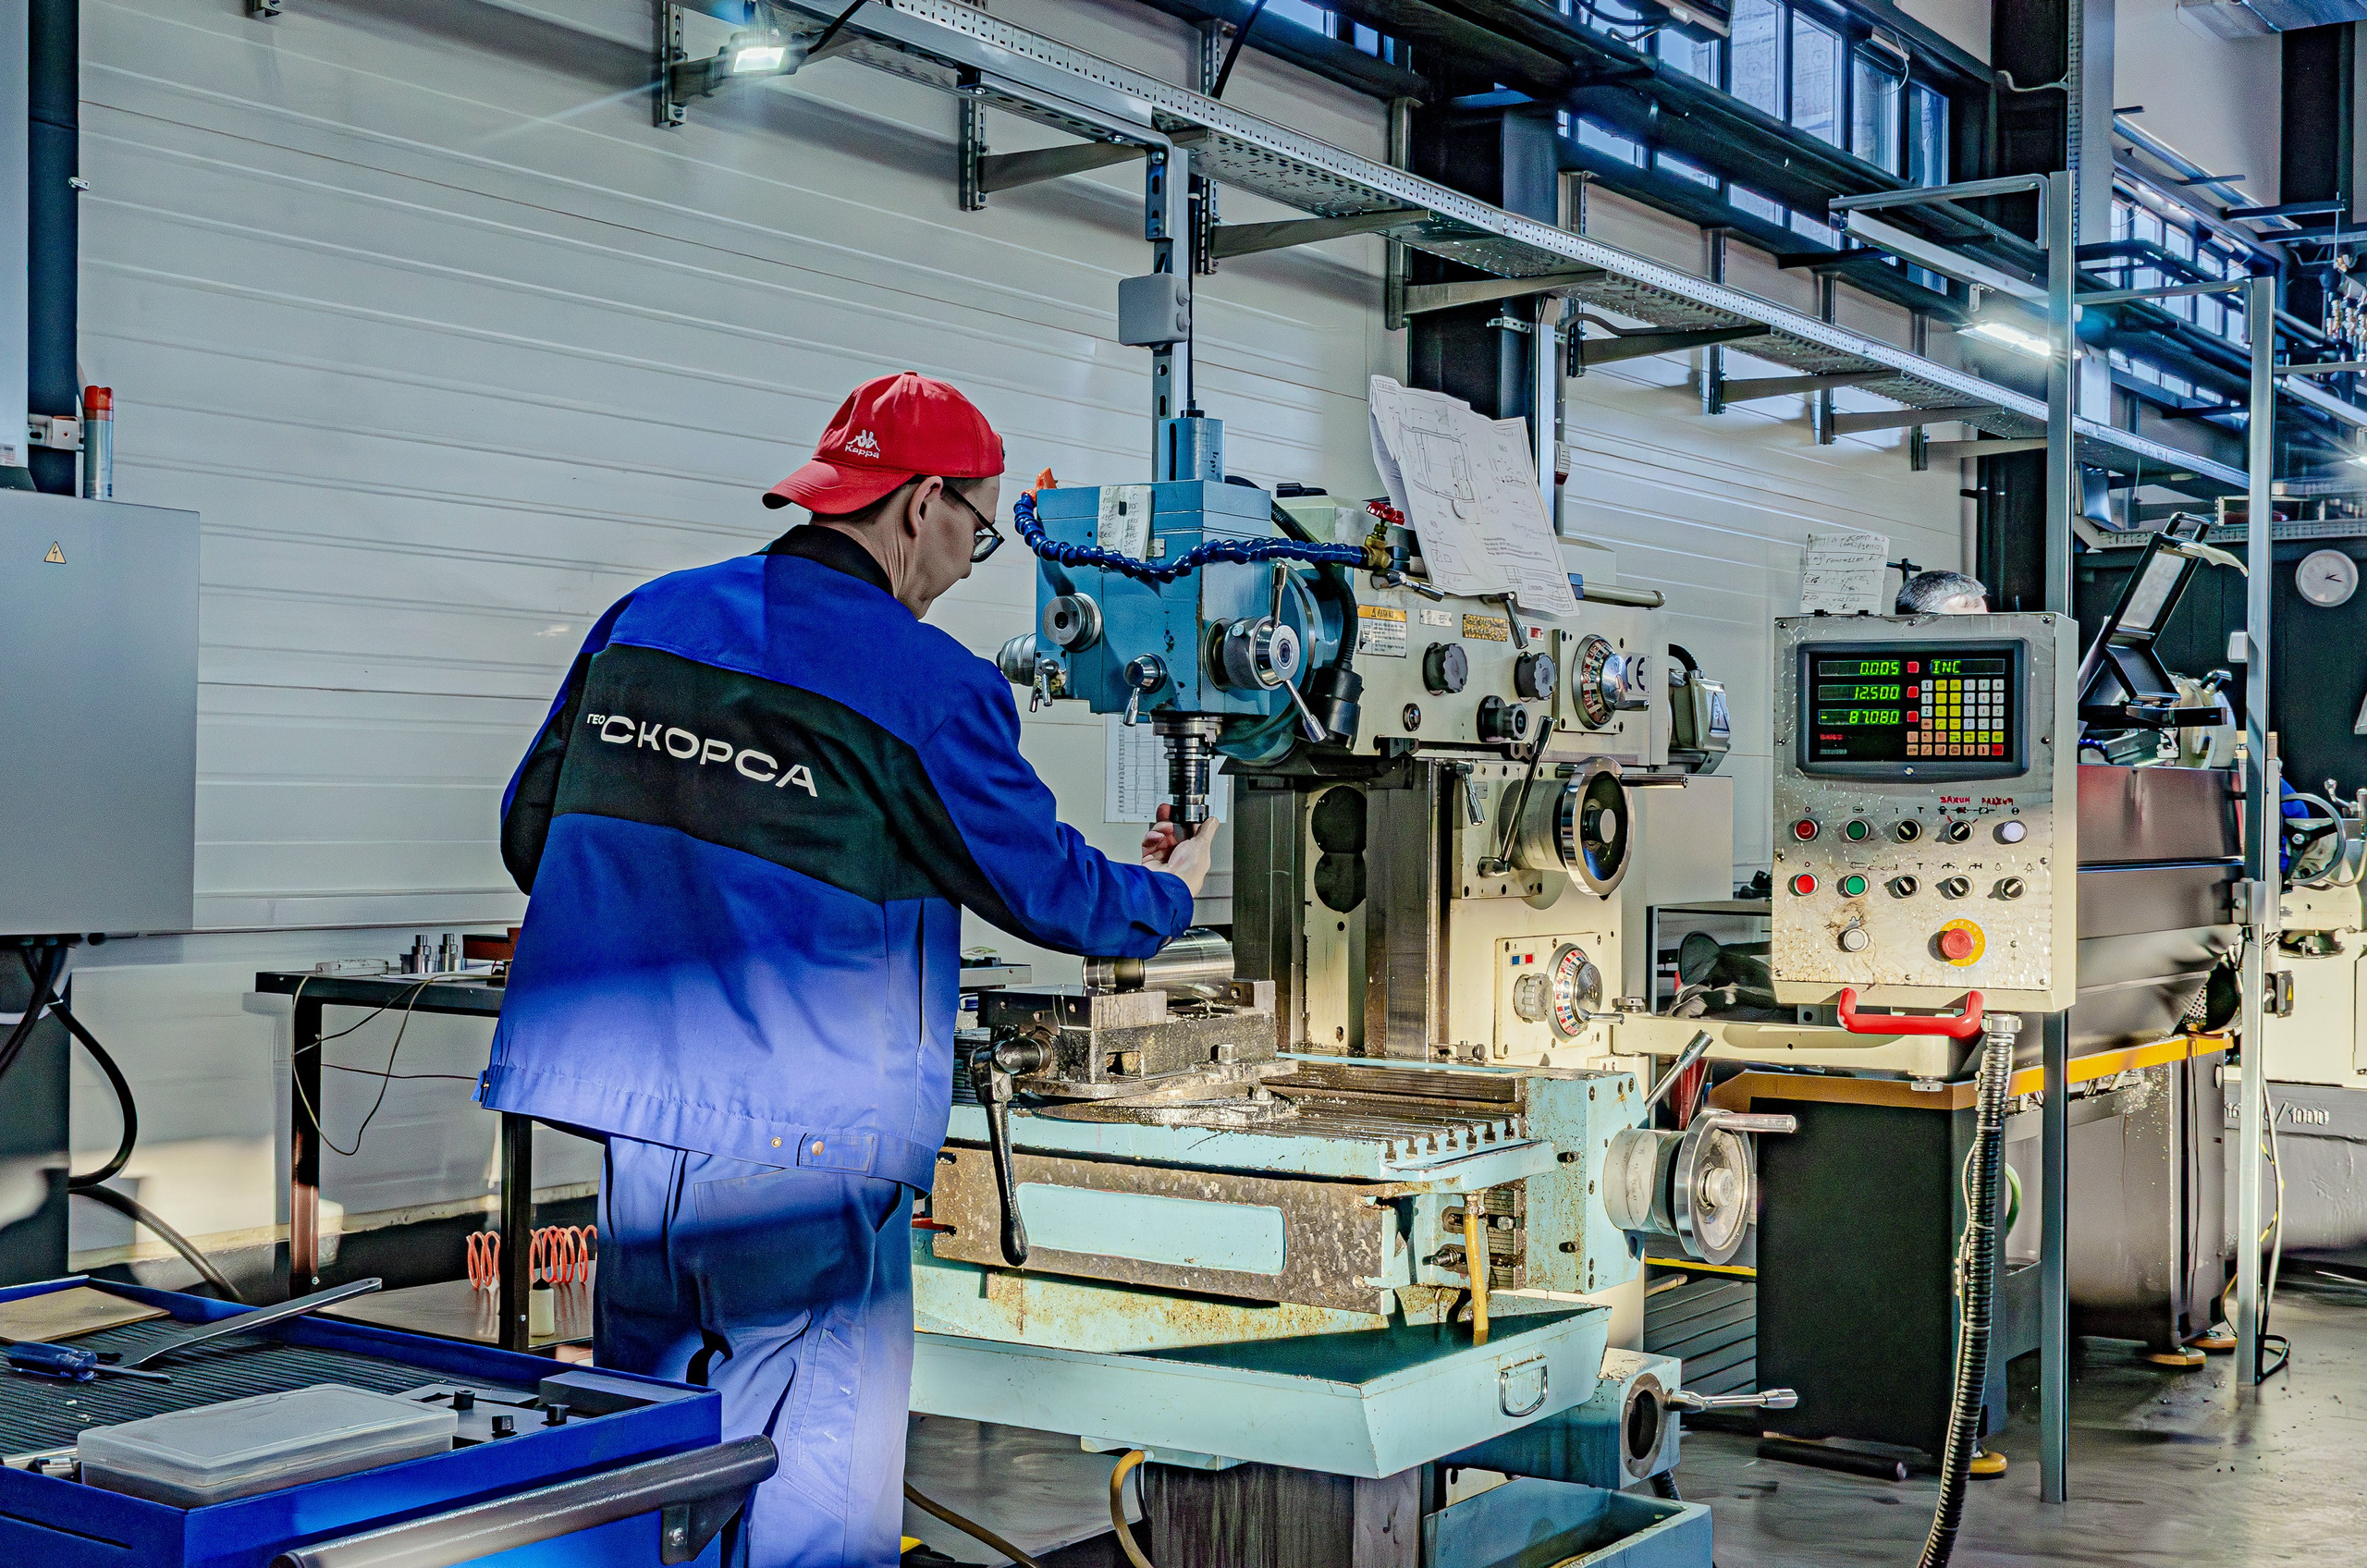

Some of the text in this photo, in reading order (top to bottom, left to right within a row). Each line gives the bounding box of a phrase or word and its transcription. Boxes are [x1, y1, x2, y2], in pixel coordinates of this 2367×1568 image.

[844, 444, 879, 459] Kappa
[1859, 661, 1899, 675] 0.005
[1932, 660, 1961, 674] INC
[1855, 686, 1900, 700] 12.500
[600, 715, 818, 798] СКОРСА
